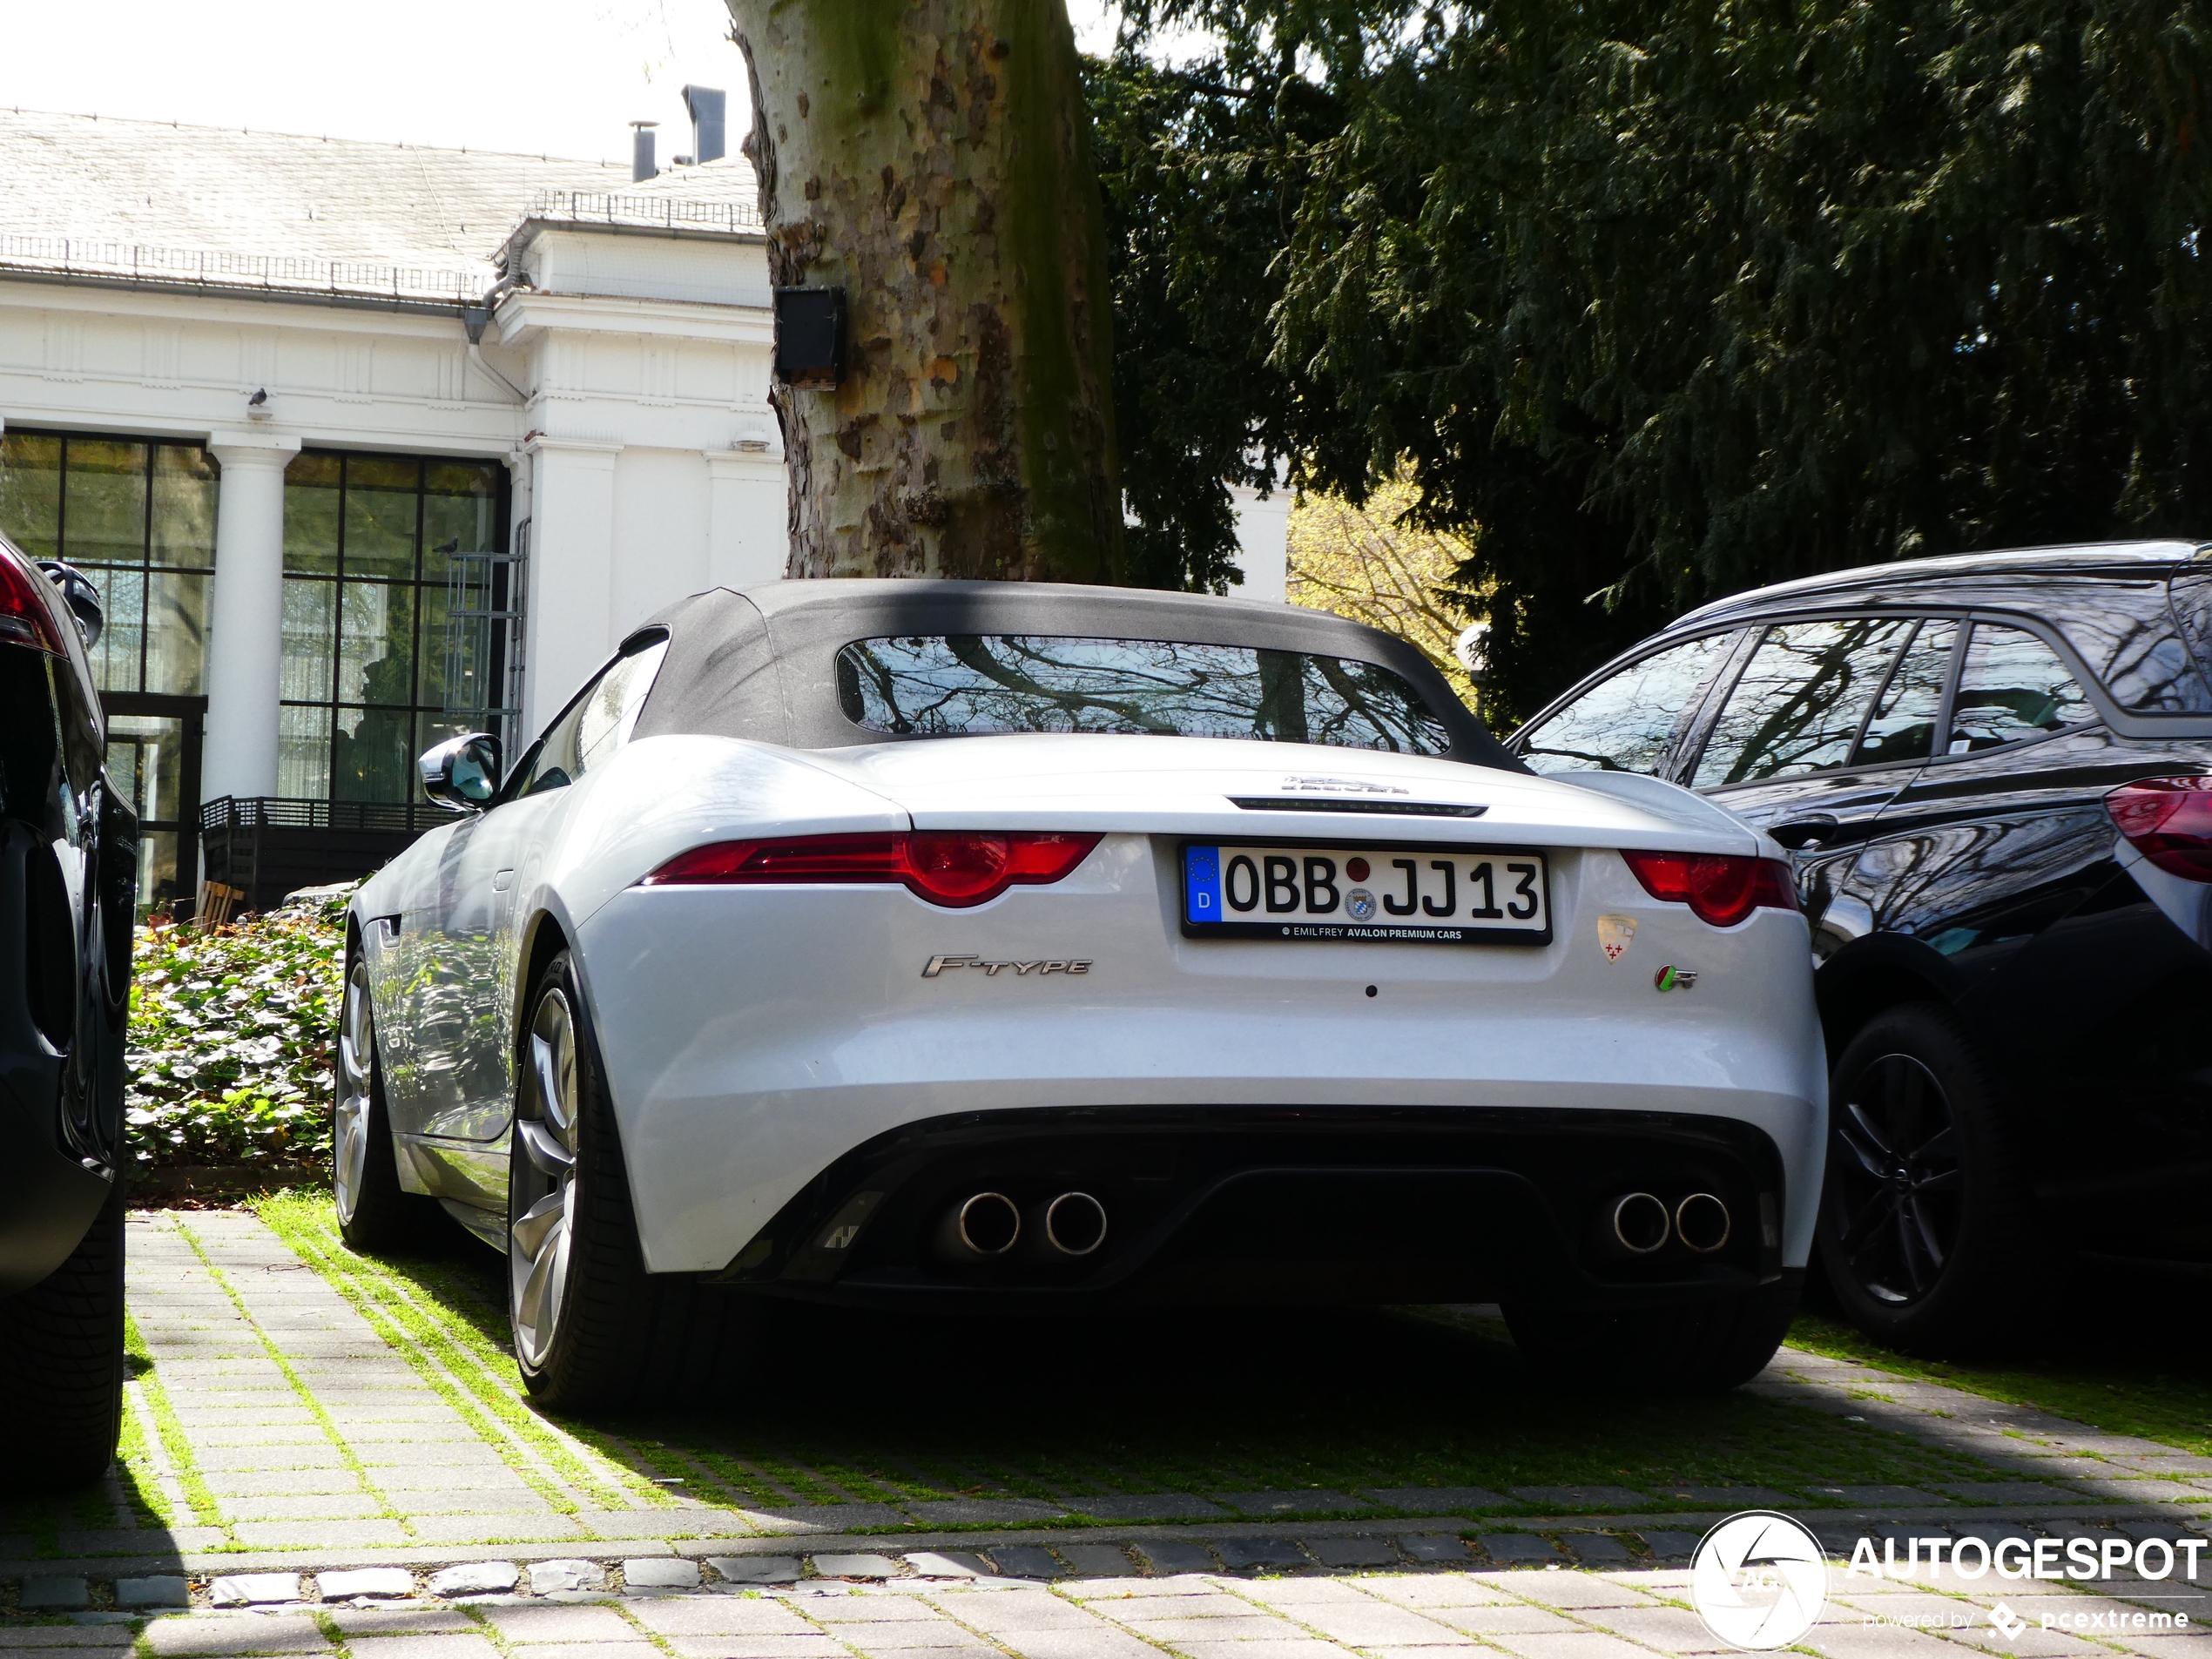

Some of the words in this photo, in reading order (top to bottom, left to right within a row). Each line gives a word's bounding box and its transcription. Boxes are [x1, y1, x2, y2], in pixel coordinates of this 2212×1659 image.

[1224, 854, 1340, 914] OBB
[1383, 859, 1456, 917] JJ
[1470, 862, 1538, 920] 13
[1197, 892, 1211, 908] D
[1347, 928, 1387, 938] AVALON
[1389, 929, 1435, 939] PREMIUM
[1437, 930, 1462, 940] CARS
[921, 954, 1093, 978] F-TYPE
